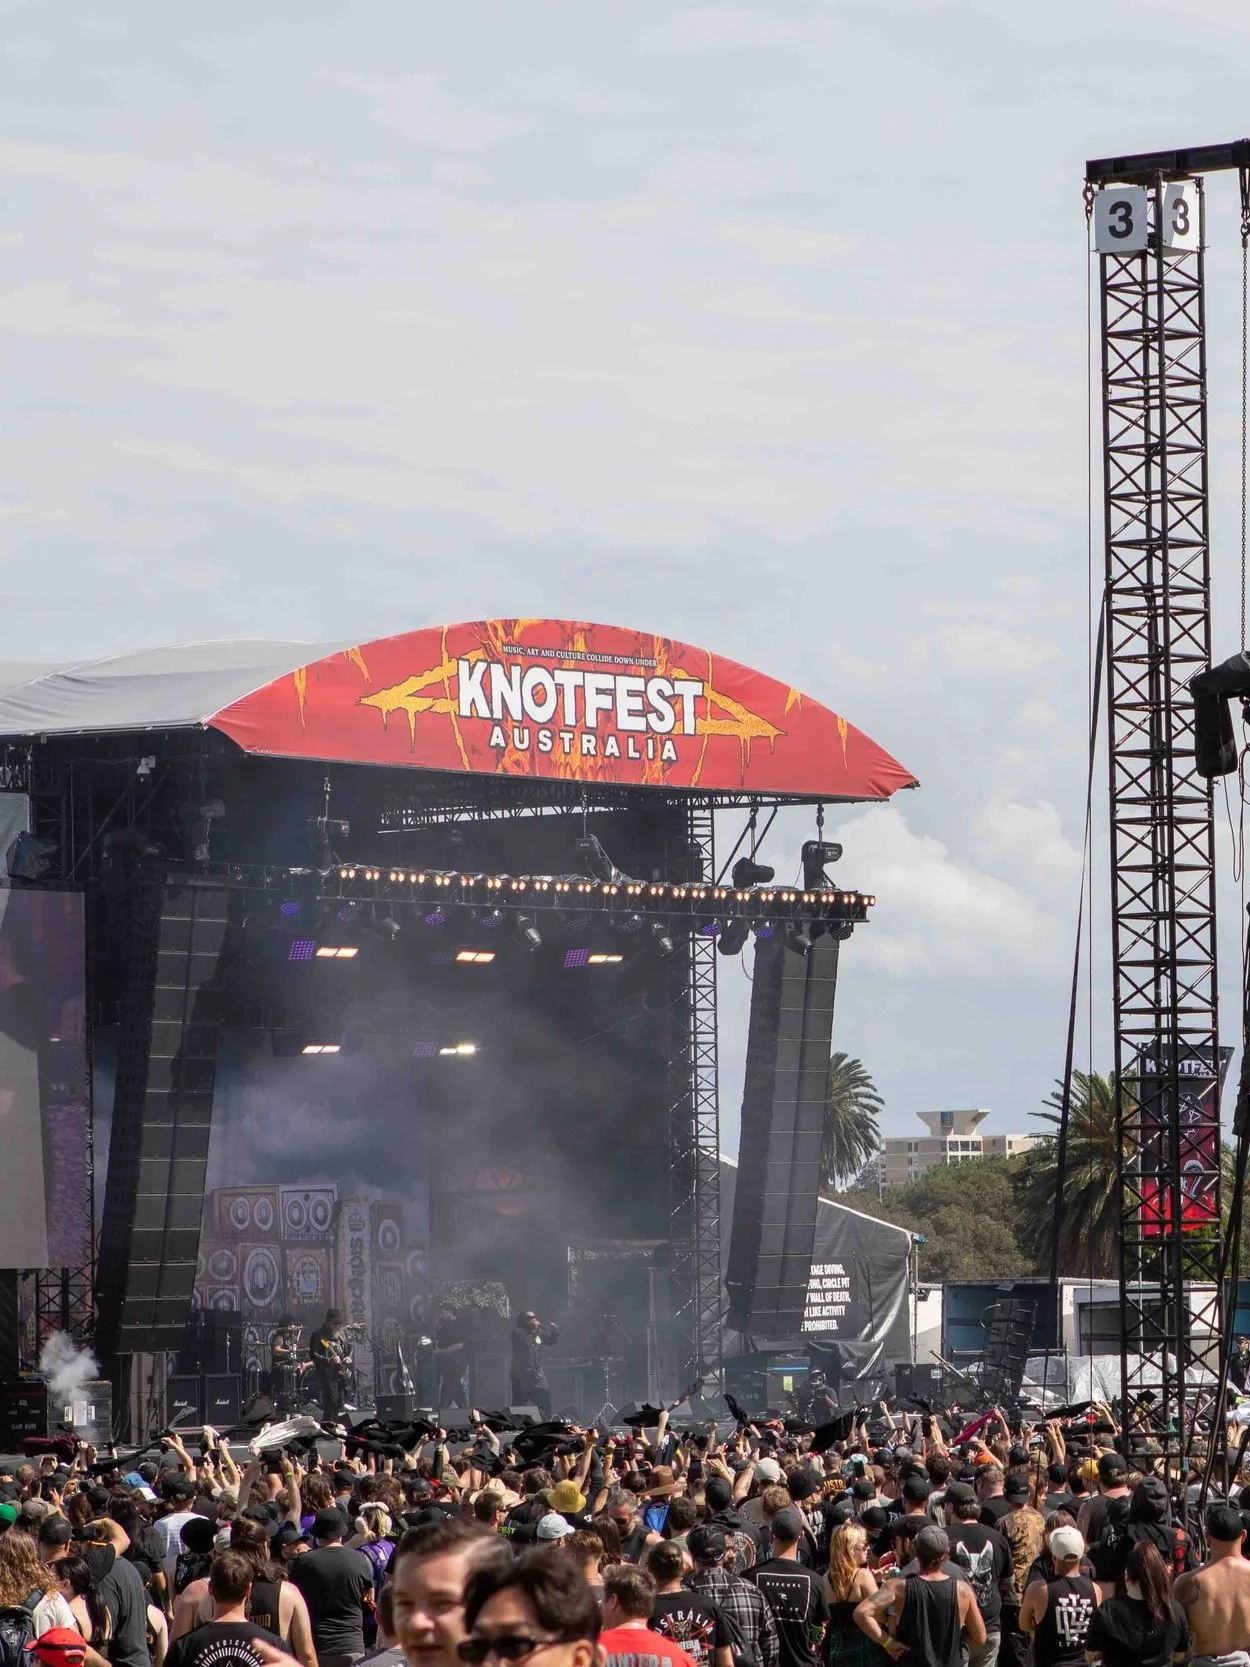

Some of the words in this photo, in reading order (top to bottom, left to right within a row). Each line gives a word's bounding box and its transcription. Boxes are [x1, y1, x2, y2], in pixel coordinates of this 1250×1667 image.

[1108, 201, 1134, 239] 3
[1172, 198, 1190, 236] 3
[503, 645, 526, 656] MUSIC,
[527, 648, 540, 656] ART
[541, 649, 555, 658] AND
[556, 651, 586, 661] CULTURE
[586, 653, 613, 663] COLLIDE
[614, 656, 635, 665] DOWN
[635, 658, 658, 668] UNDER
[457, 659, 704, 736] KNOTFEST
[489, 726, 678, 761] AUSTRALIA
[822, 1277, 842, 1289] CIRCLE
[841, 1277, 850, 1288] PIT
[810, 1292, 825, 1303] WALL
[825, 1291, 832, 1303] OF
[809, 1306, 822, 1318] LIKE
[822, 1305, 846, 1317] ACTIVITY
[654, 1608, 714, 1635] USTRALIA
